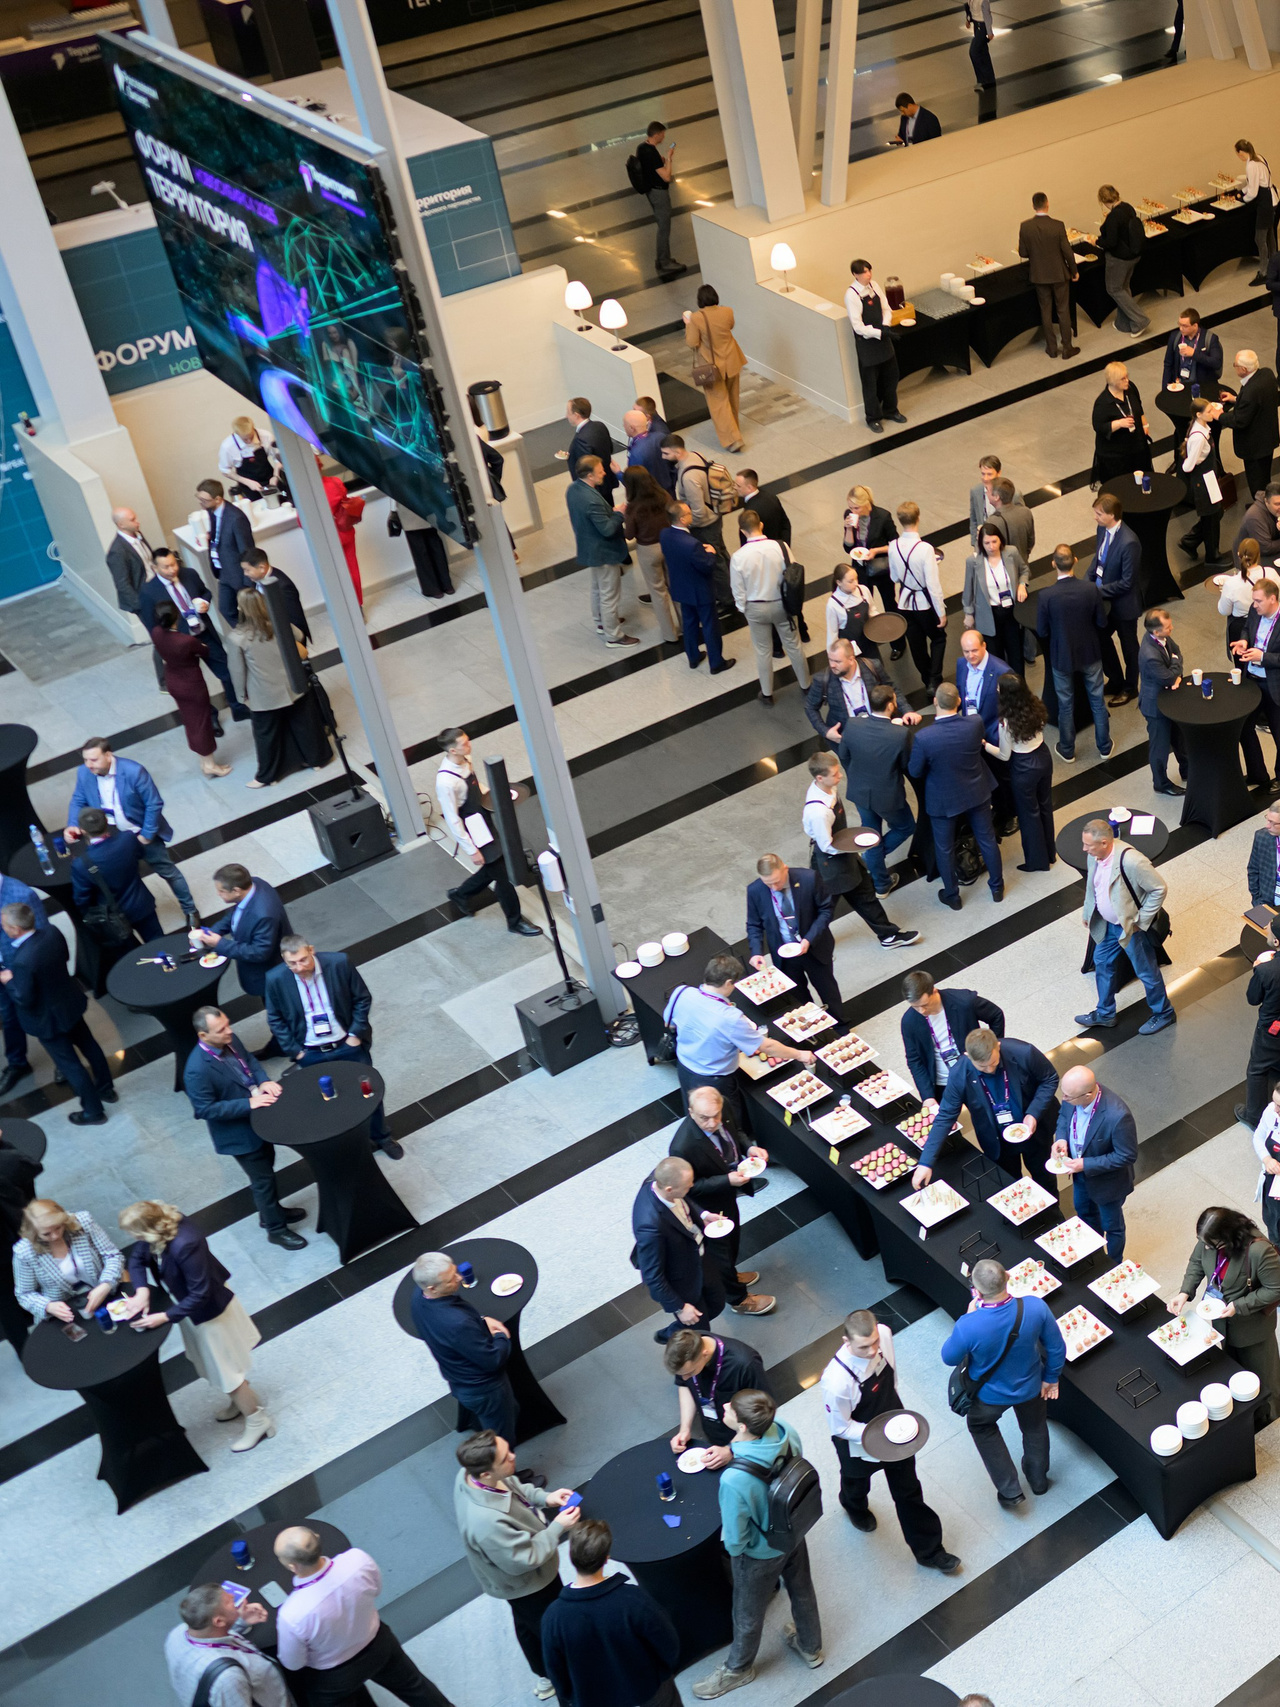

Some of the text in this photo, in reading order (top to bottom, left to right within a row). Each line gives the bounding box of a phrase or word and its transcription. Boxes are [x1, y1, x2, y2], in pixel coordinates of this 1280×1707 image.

[135, 129, 195, 184] ФОРУМ
[145, 166, 255, 253] ТЕРРИТОРИЯ
[96, 325, 198, 373] ФОРУМ
